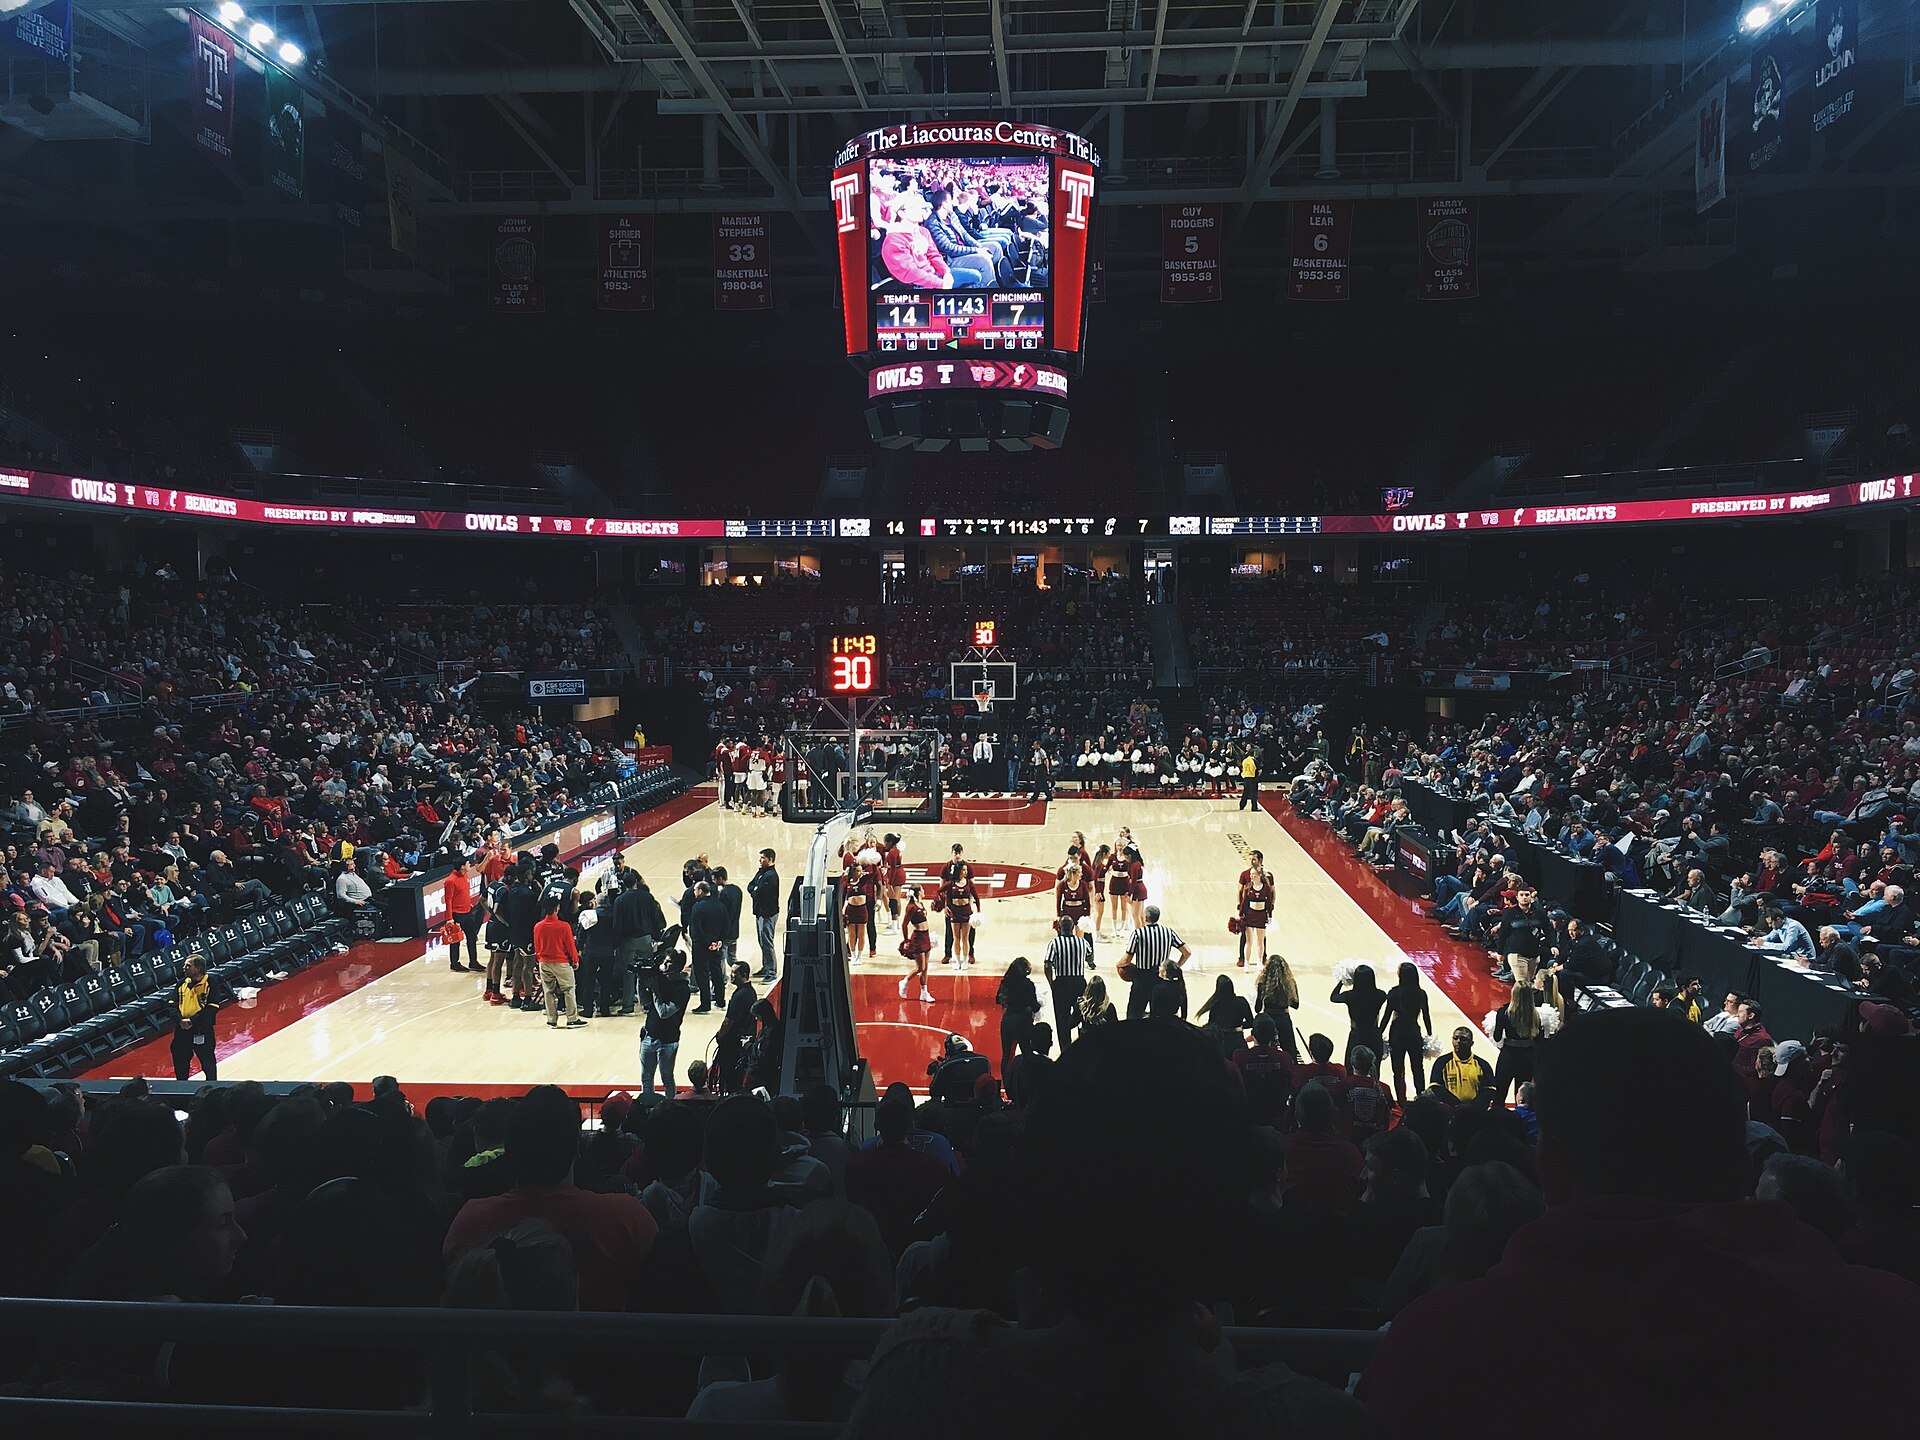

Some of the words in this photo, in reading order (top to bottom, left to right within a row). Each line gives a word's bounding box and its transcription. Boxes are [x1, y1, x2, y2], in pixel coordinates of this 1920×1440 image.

[867, 129, 898, 151] The
[900, 124, 991, 145] Liacouras
[995, 122, 1057, 149] Center
[1066, 134, 1089, 159] The
[1182, 207, 1202, 217] GUY
[1312, 205, 1332, 214] HAL
[1428, 207, 1468, 216] LITWACK
[619, 219, 631, 227] AL
[722, 216, 760, 225] MARILYN
[1170, 218, 1215, 229] RODGERS
[1309, 217, 1334, 226] LEAR
[609, 229, 641, 239] SHRIER
[719, 228, 764, 237] STEPHENS
[1184, 236, 1199, 253] 5
[1314, 234, 1328, 251] 6
[729, 245, 756, 262] 33
[1164, 260, 1217, 270] BASKETBALL
[1293, 258, 1347, 268] BASKETBALL
[603, 270, 647, 279] ATHLETICS
[717, 269, 769, 278] BASKETBALL
[1170, 273, 1212, 282] 1955-58
[1298, 270, 1341, 280] 1953-56
[722, 281, 763, 290] 1980-84
[883, 295, 920, 304] TEMPLE
[992, 293, 1041, 303] CINCINNATI
[937, 298, 985, 315] 11:43
[889, 306, 917, 327] 14
[1010, 305, 1025, 326] 7
[957, 328, 963, 336] 1
[886, 341, 892, 349] 2
[909, 341, 916, 349] 4
[1007, 340, 1013, 348] 4
[1026, 339, 1032, 347] 6
[876, 366, 924, 390] OWLS
[937, 365, 954, 384] T
[970, 367, 996, 382] VS
[1860, 477, 1896, 502] OWLS
[1903, 475, 1913, 495] T
[71, 478, 117, 503] OWLS
[124, 486, 135, 505] T
[145, 490, 160, 506] VS
[185, 495, 237, 516] BEARCATS
[264, 507, 327, 521] PRESENTED
[330, 511, 347, 522] BY
[1393, 514, 1446, 531] OWLS
[1457, 513, 1469, 528] T
[1481, 512, 1499, 525] VS
[1536, 505, 1617, 523] BEARCATS
[1692, 499, 1766, 514] PRESENTED
[1770, 497, 1785, 510] BY
[465, 513, 518, 531] OWLS
[529, 517, 542, 532] T
[554, 519, 571, 531] VS
[605, 521, 679, 535] BEARCATS
[886, 521, 905, 535] 14
[1008, 520, 1048, 534] 11:43
[1065, 525, 1072, 534] 4
[1082, 524, 1089, 534] 6
[1138, 520, 1148, 533] 7
[950, 525, 957, 534] 2
[965, 525, 972, 534] 4
[994, 525, 1000, 534] 1
[975, 629, 993, 644] 30
[832, 635, 876, 654] 11:43
[832, 656, 872, 690] 30
[775, 762, 784, 772] 24
